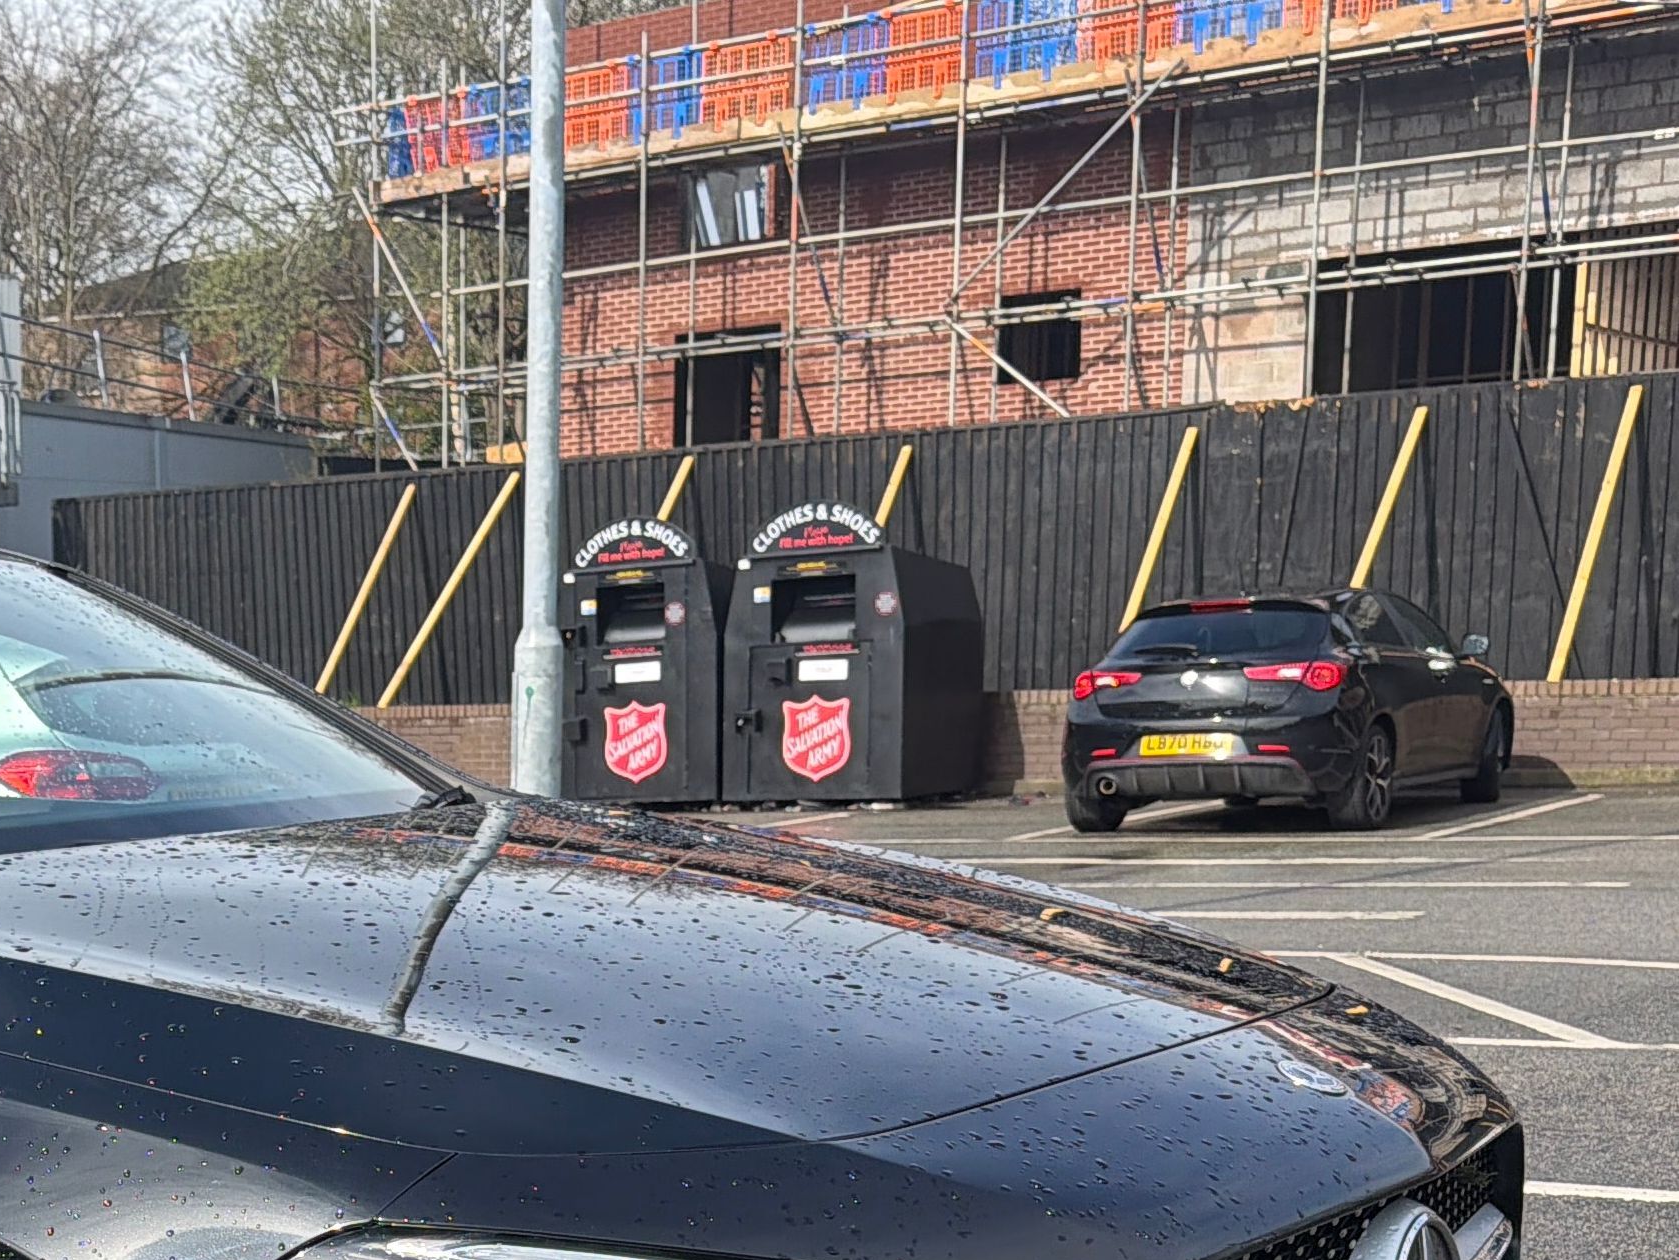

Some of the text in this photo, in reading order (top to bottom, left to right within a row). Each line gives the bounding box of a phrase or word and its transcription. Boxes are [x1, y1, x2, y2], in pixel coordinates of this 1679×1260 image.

[575, 519, 689, 568] CLOTHES & SHOES
[752, 503, 881, 553] CLOTHES & SHOES
[608, 714, 661, 763] SALVATION
[617, 710, 639, 736] THE
[786, 709, 843, 760] SALVATION
[795, 704, 819, 732] THE
[627, 737, 658, 774] ARMY
[807, 734, 841, 770] ARMY
